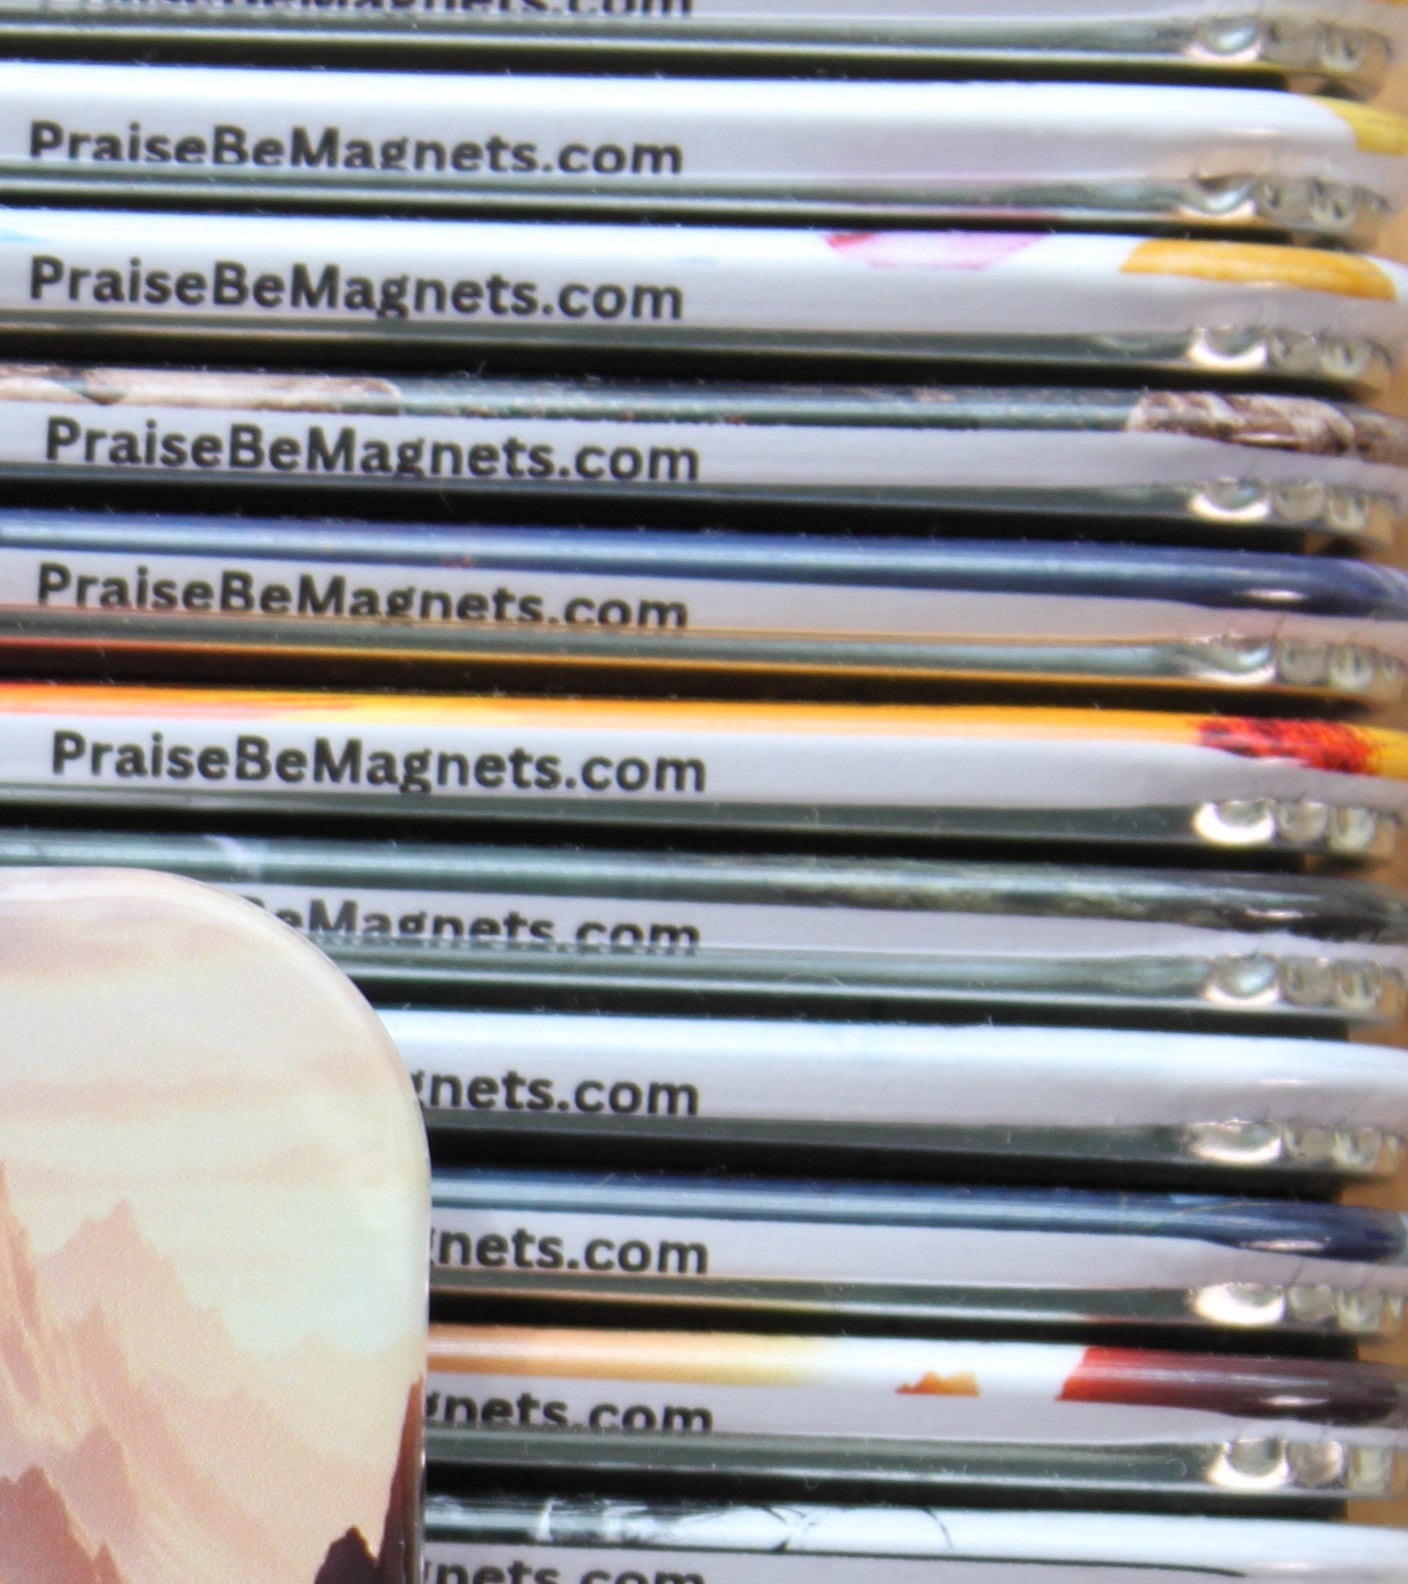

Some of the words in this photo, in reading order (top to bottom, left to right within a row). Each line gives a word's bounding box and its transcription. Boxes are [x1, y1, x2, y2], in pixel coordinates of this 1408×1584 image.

[28, 120, 684, 176] PraiseBeMagnets.com
[28, 255, 684, 322] PraiseBeMagnets.com
[45, 416, 700, 483] PraiseBeMagnets.com
[37, 561, 690, 630] PraiseBeMagnets.com
[51, 729, 707, 797] PraiseBeMagnets.com
